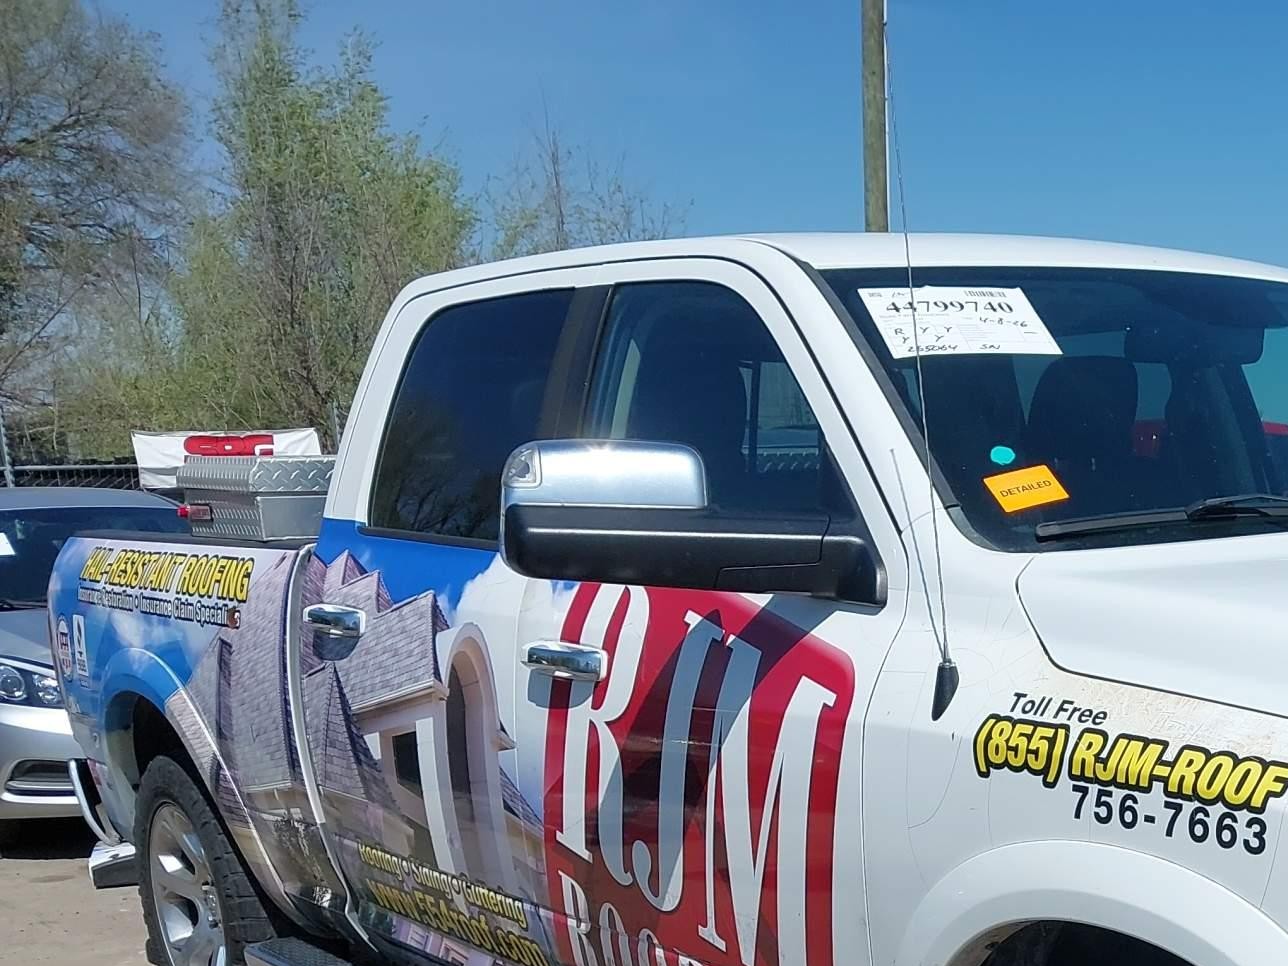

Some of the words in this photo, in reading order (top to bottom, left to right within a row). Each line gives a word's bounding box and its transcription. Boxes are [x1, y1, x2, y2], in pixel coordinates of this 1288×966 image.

[886, 300, 1014, 314] 44799740
[999, 480, 1053, 498] DETAILED
[80, 546, 186, 592] HAIL-RESISTANT
[177, 554, 255, 602] ROOFING
[140, 593, 172, 618] Insurance
[173, 598, 194, 622] Claim
[195, 603, 241, 630] Specialis
[1008, 692, 1046, 717] Toll
[1053, 699, 1108, 726] Free
[974, 714, 1069, 786] (855)
[1071, 786, 1267, 855] 756-7663
[358, 838, 402, 881] Roofing
[410, 859, 454, 899] Siding
[462, 875, 529, 932] Guttering
